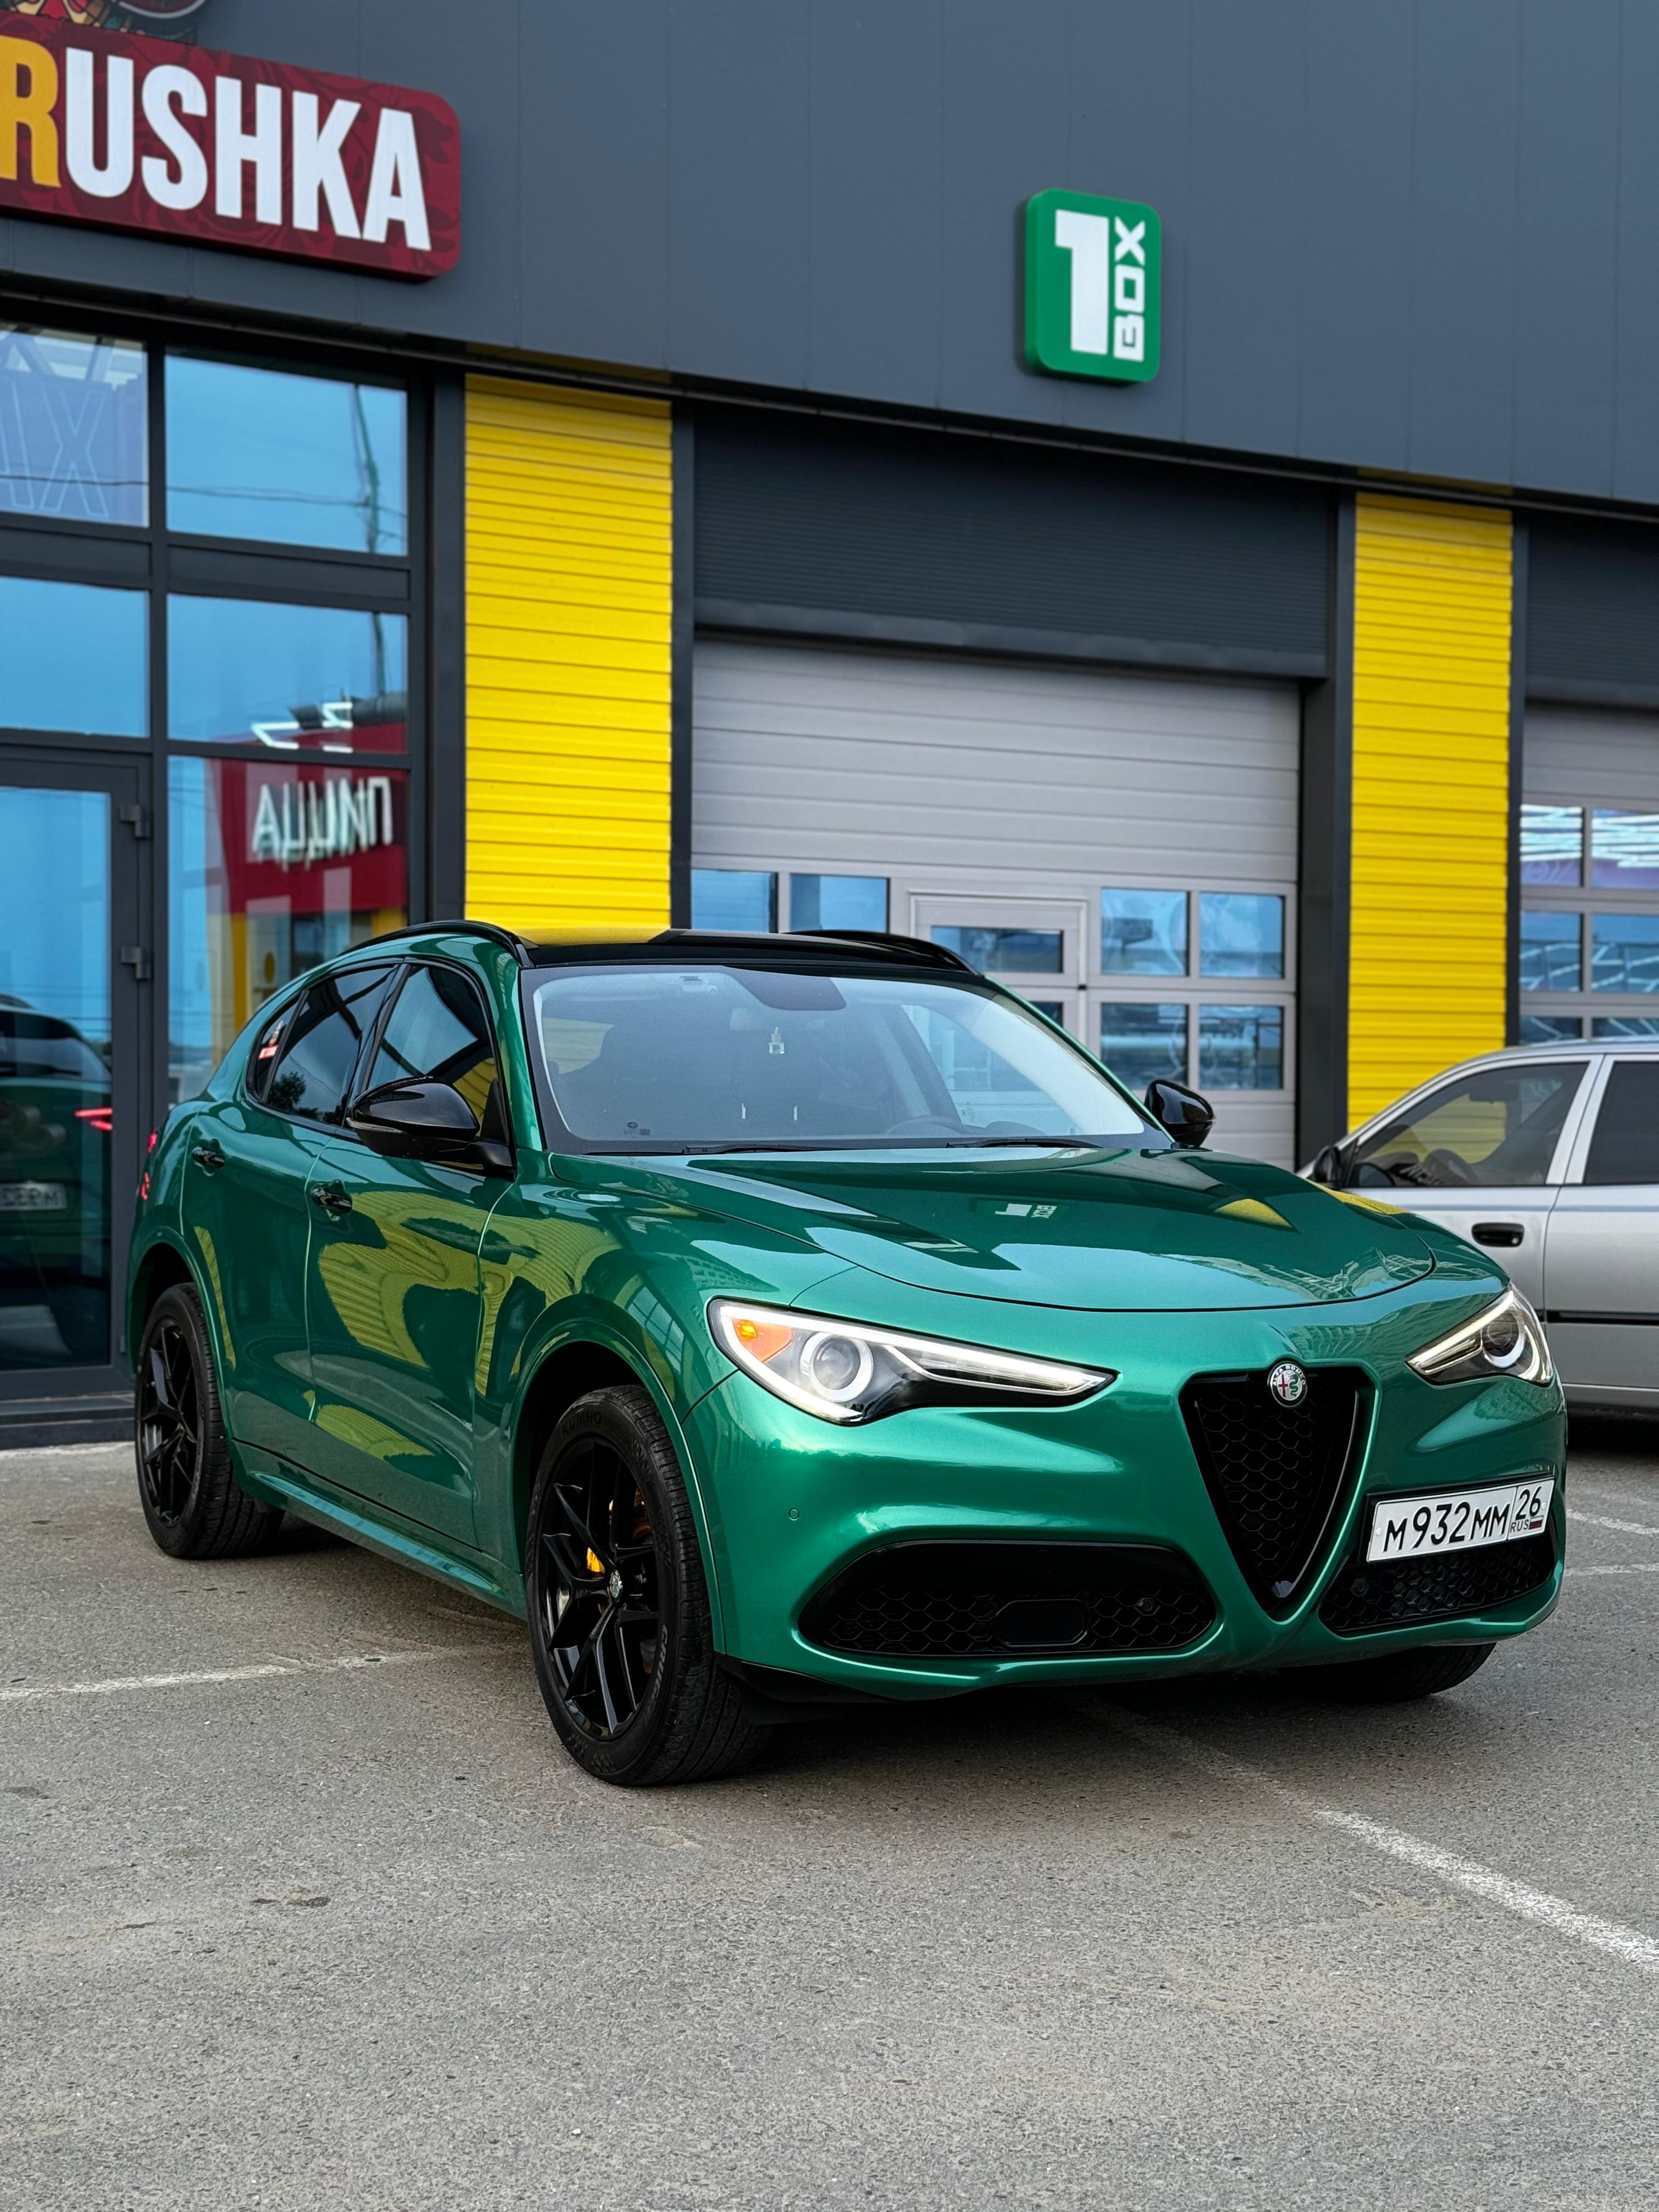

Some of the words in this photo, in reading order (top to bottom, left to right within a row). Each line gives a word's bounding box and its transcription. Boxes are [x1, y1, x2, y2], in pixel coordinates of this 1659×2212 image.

[0, 35, 431, 251] RUSHKA
[1055, 208, 1109, 356] 1
[1113, 216, 1146, 362] BOX
[1510, 1519, 1529, 1533] RUS
[1515, 1486, 1542, 1520] 26
